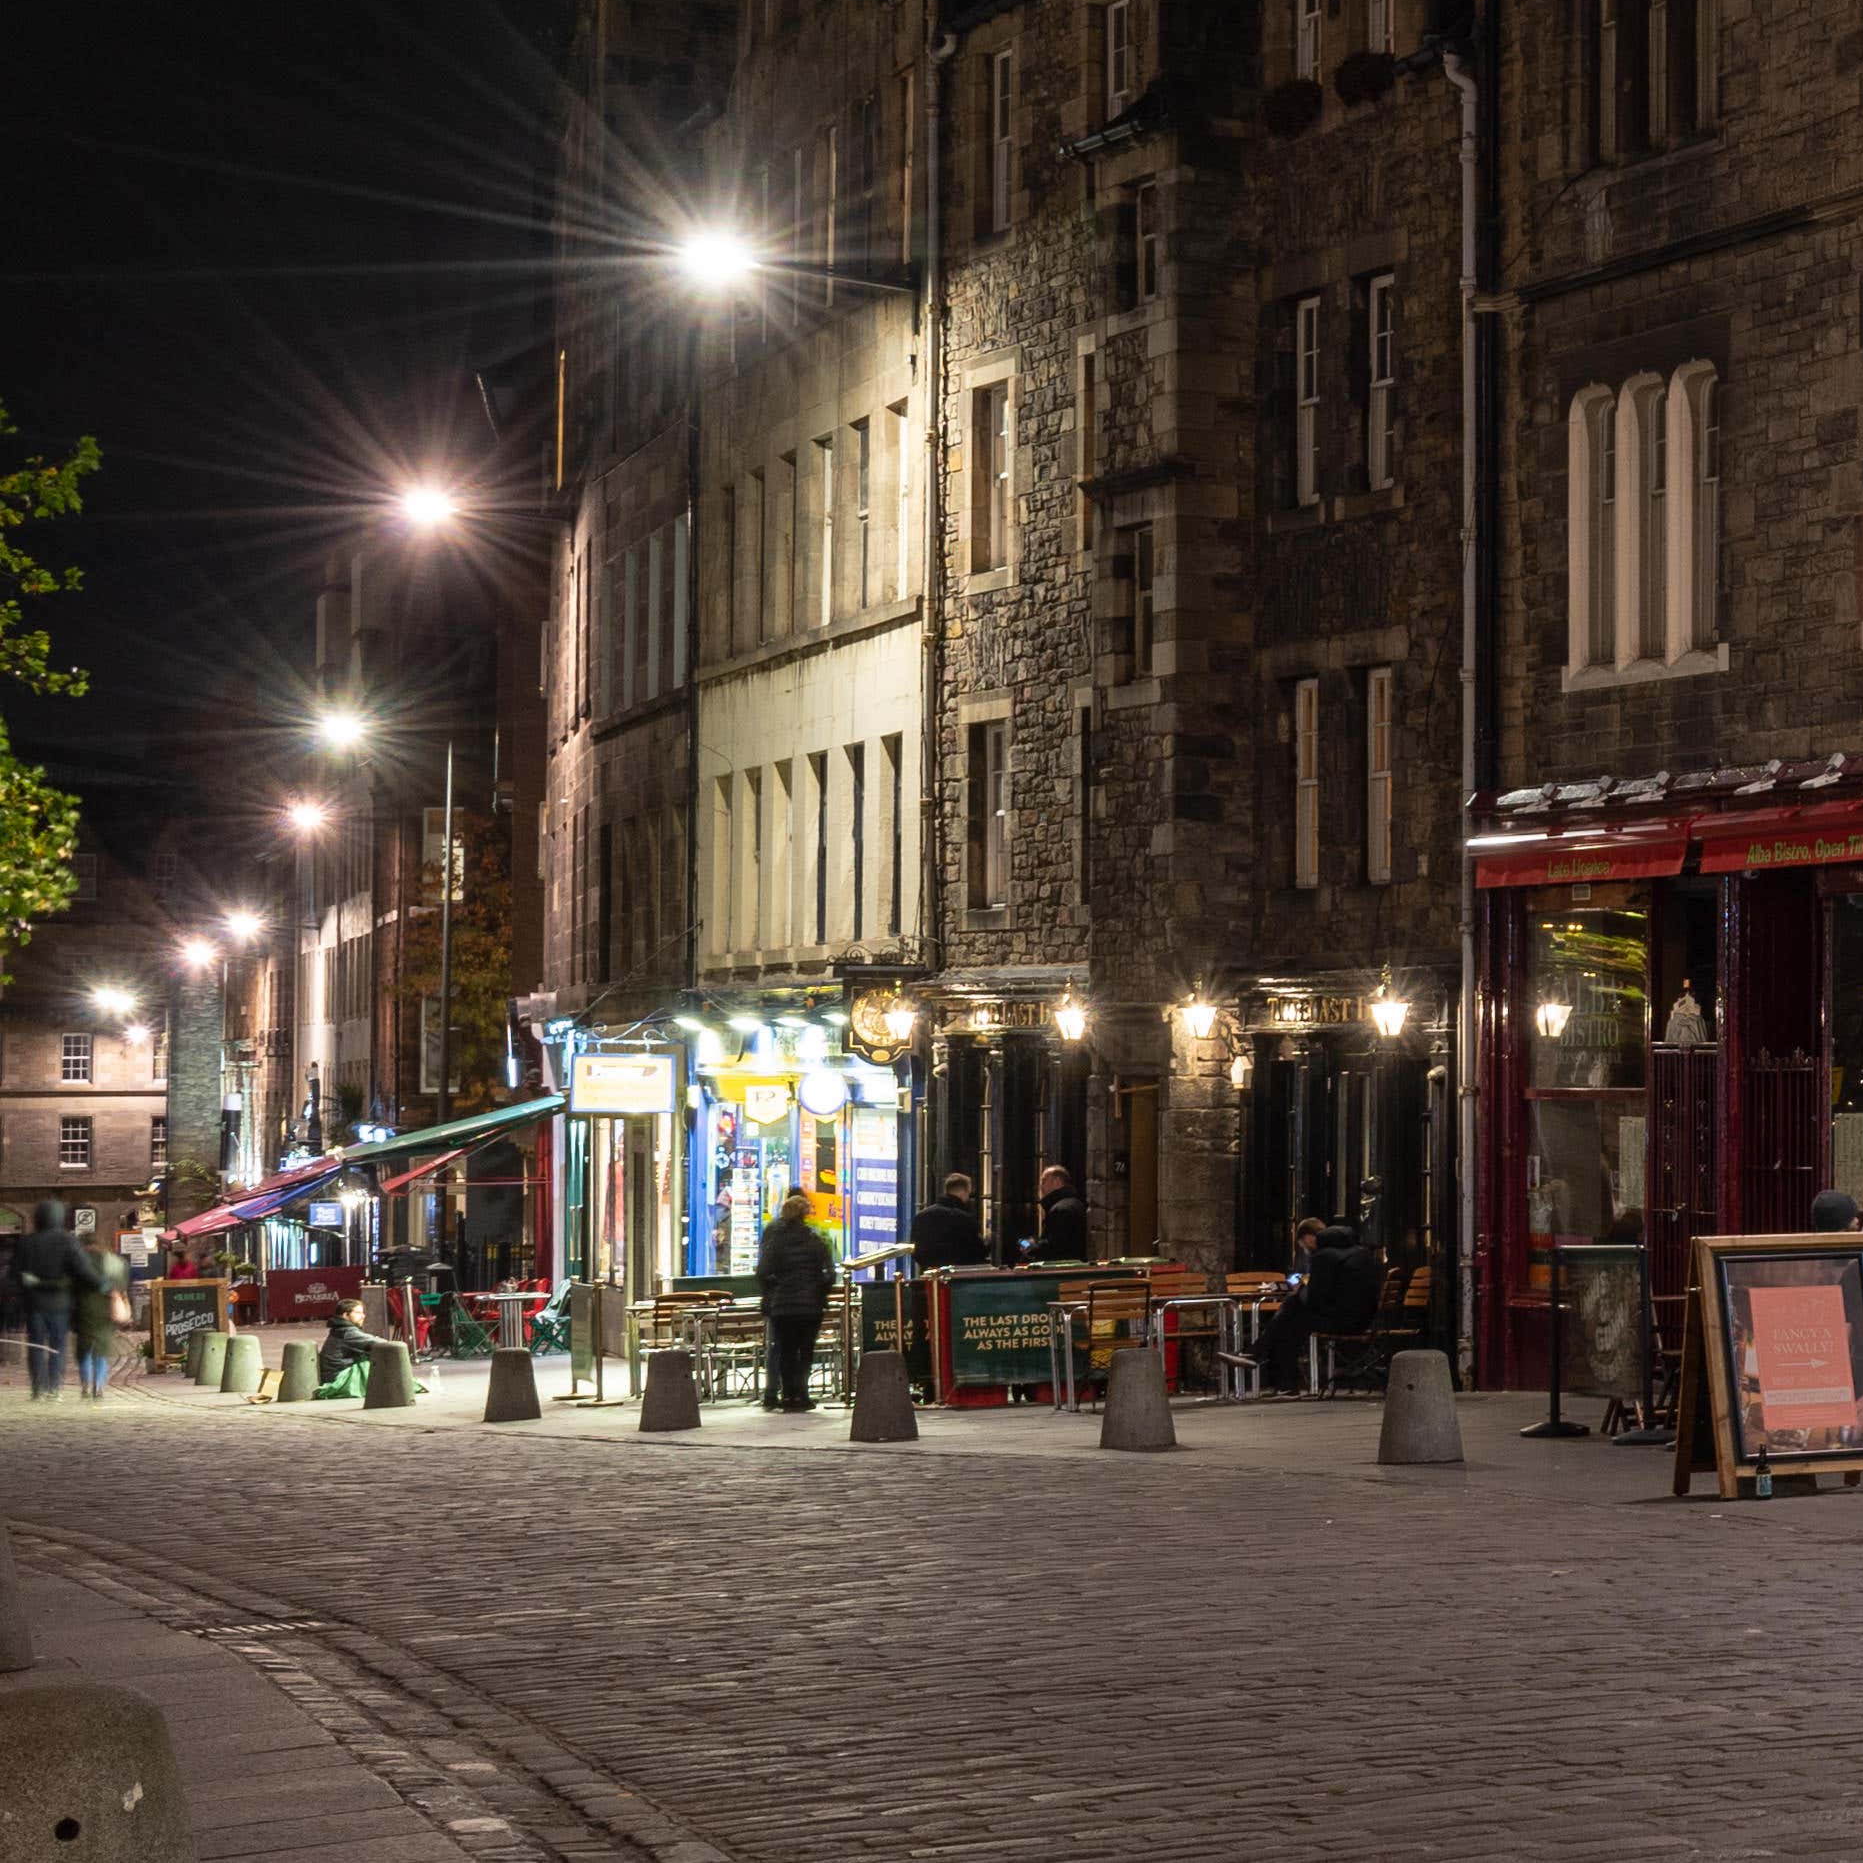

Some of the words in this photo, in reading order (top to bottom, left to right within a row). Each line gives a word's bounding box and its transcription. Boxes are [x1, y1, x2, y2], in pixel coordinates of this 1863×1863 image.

[1747, 843, 1771, 864] Alba
[1774, 841, 1811, 864] Bistro,
[1815, 838, 1845, 861] Open
[1848, 834, 1863, 856] Till
[1547, 861, 1569, 878] Late
[1003, 1001, 1036, 1026] LAST
[1310, 997, 1350, 1022] LAST
[165, 1312, 215, 1338] PROSECCO
[875, 1320, 897, 1330] THE
[963, 1317, 987, 1327] THE
[990, 1315, 1018, 1325] LAST
[964, 1327, 1010, 1339] ALWAYS
[1013, 1326, 1029, 1337] AS
[1774, 1329, 1818, 1341] FANCY
[1822, 1328, 1834, 1339] A
[977, 1339, 993, 1350] AS
[995, 1338, 1019, 1349] THE
[1022, 1336, 1052, 1348] FIRST
[1776, 1341, 1836, 1355] SWALLY?
